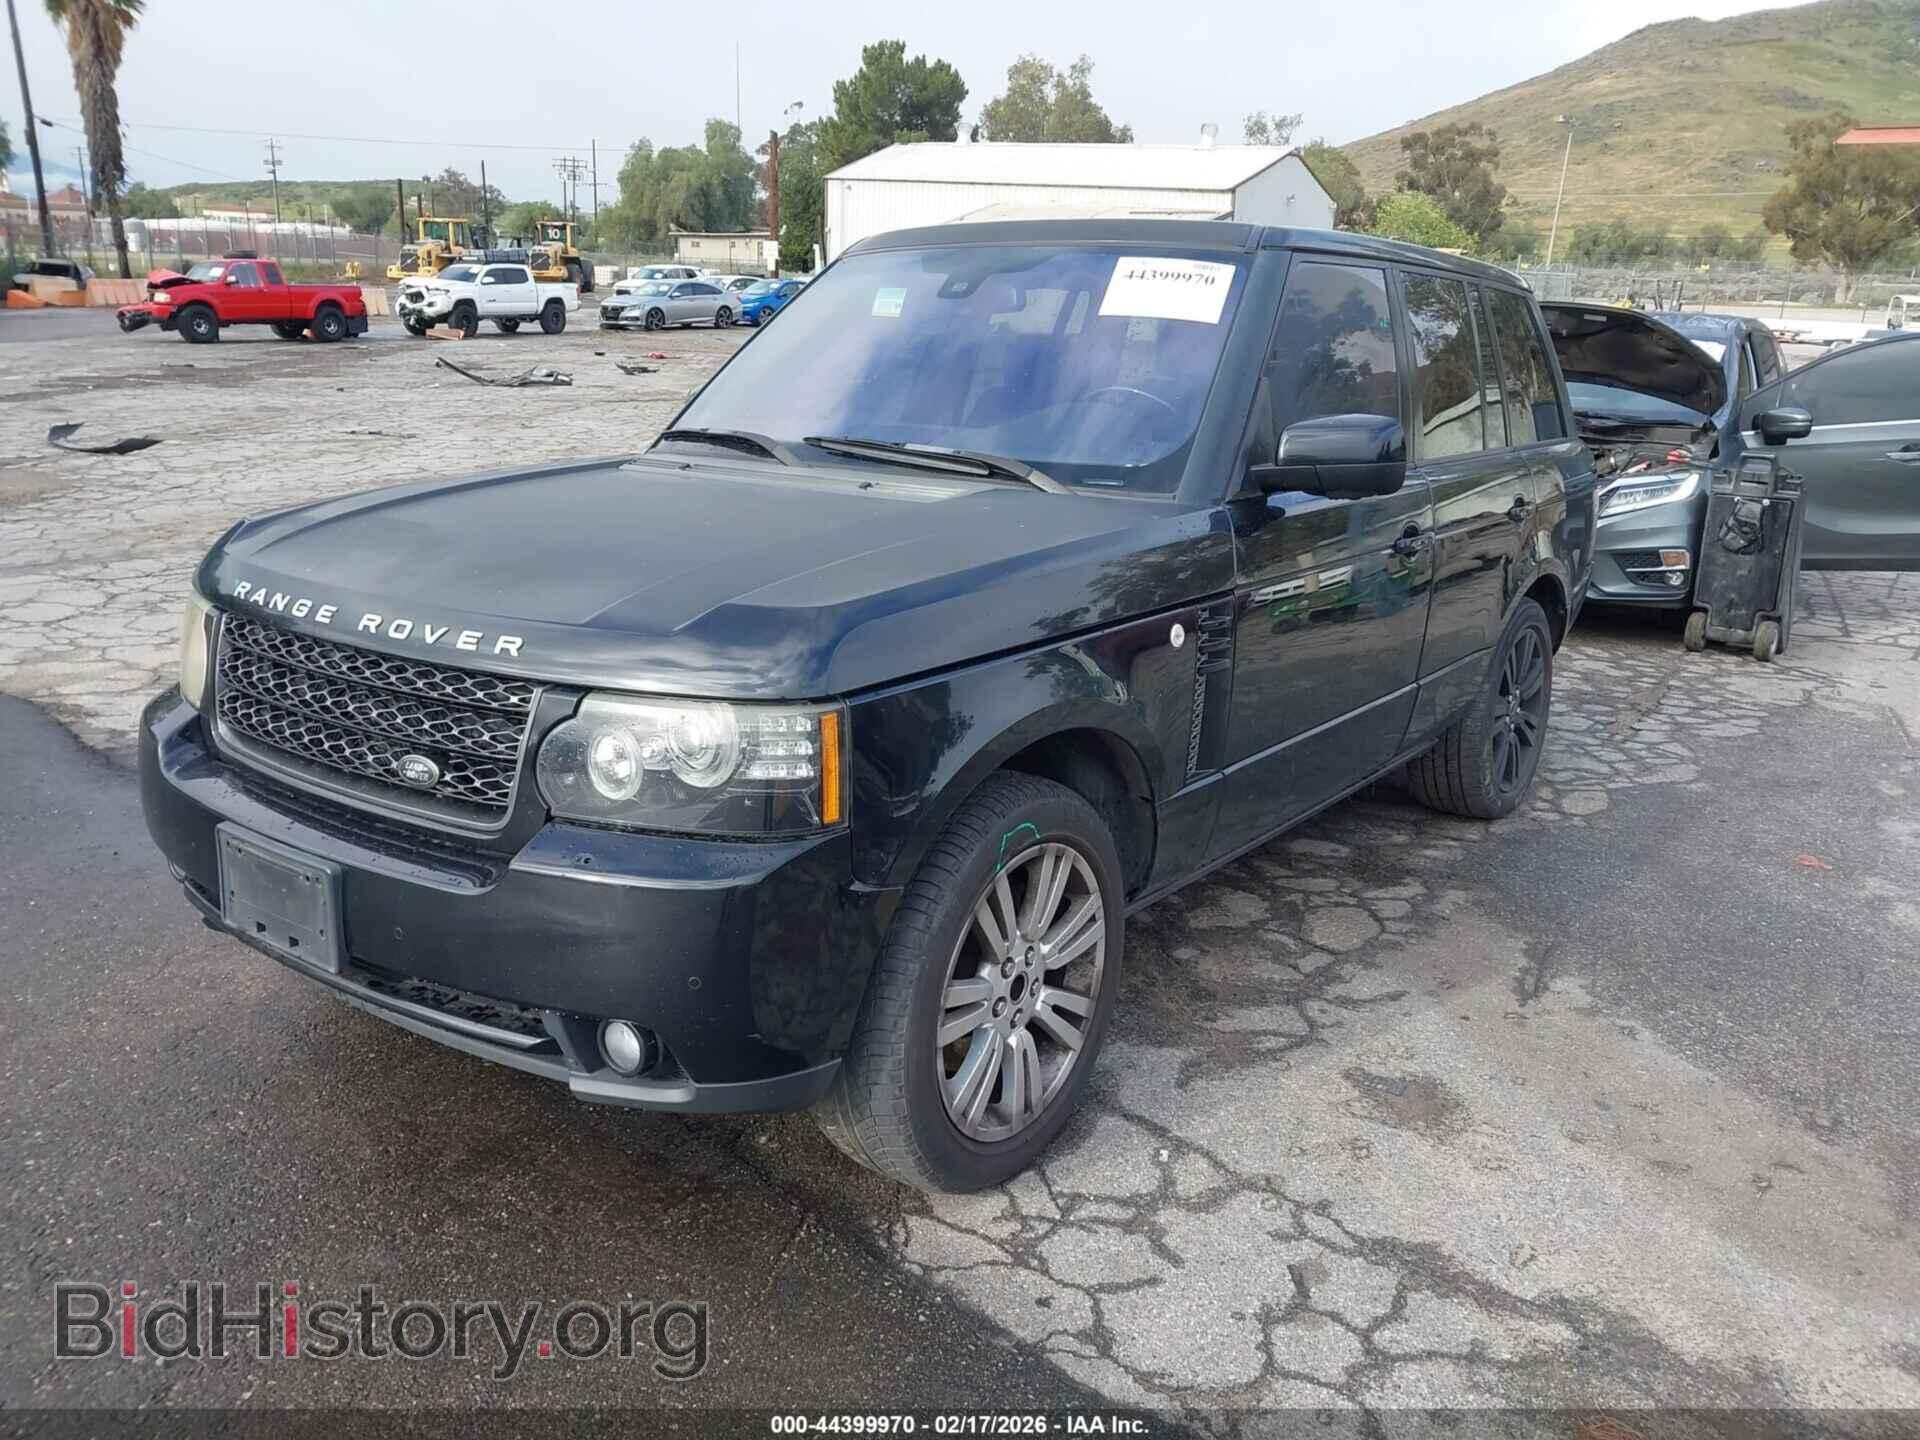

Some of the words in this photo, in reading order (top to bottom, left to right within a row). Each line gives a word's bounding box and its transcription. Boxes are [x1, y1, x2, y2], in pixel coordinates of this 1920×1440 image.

[547, 228, 561, 239] 10
[1123, 269, 1216, 286] 44399970
[232, 580, 339, 624] RANGE
[357, 613, 525, 658] ROVER
[405, 760, 425, 772] LAND
[406, 770, 429, 781] ROVER
